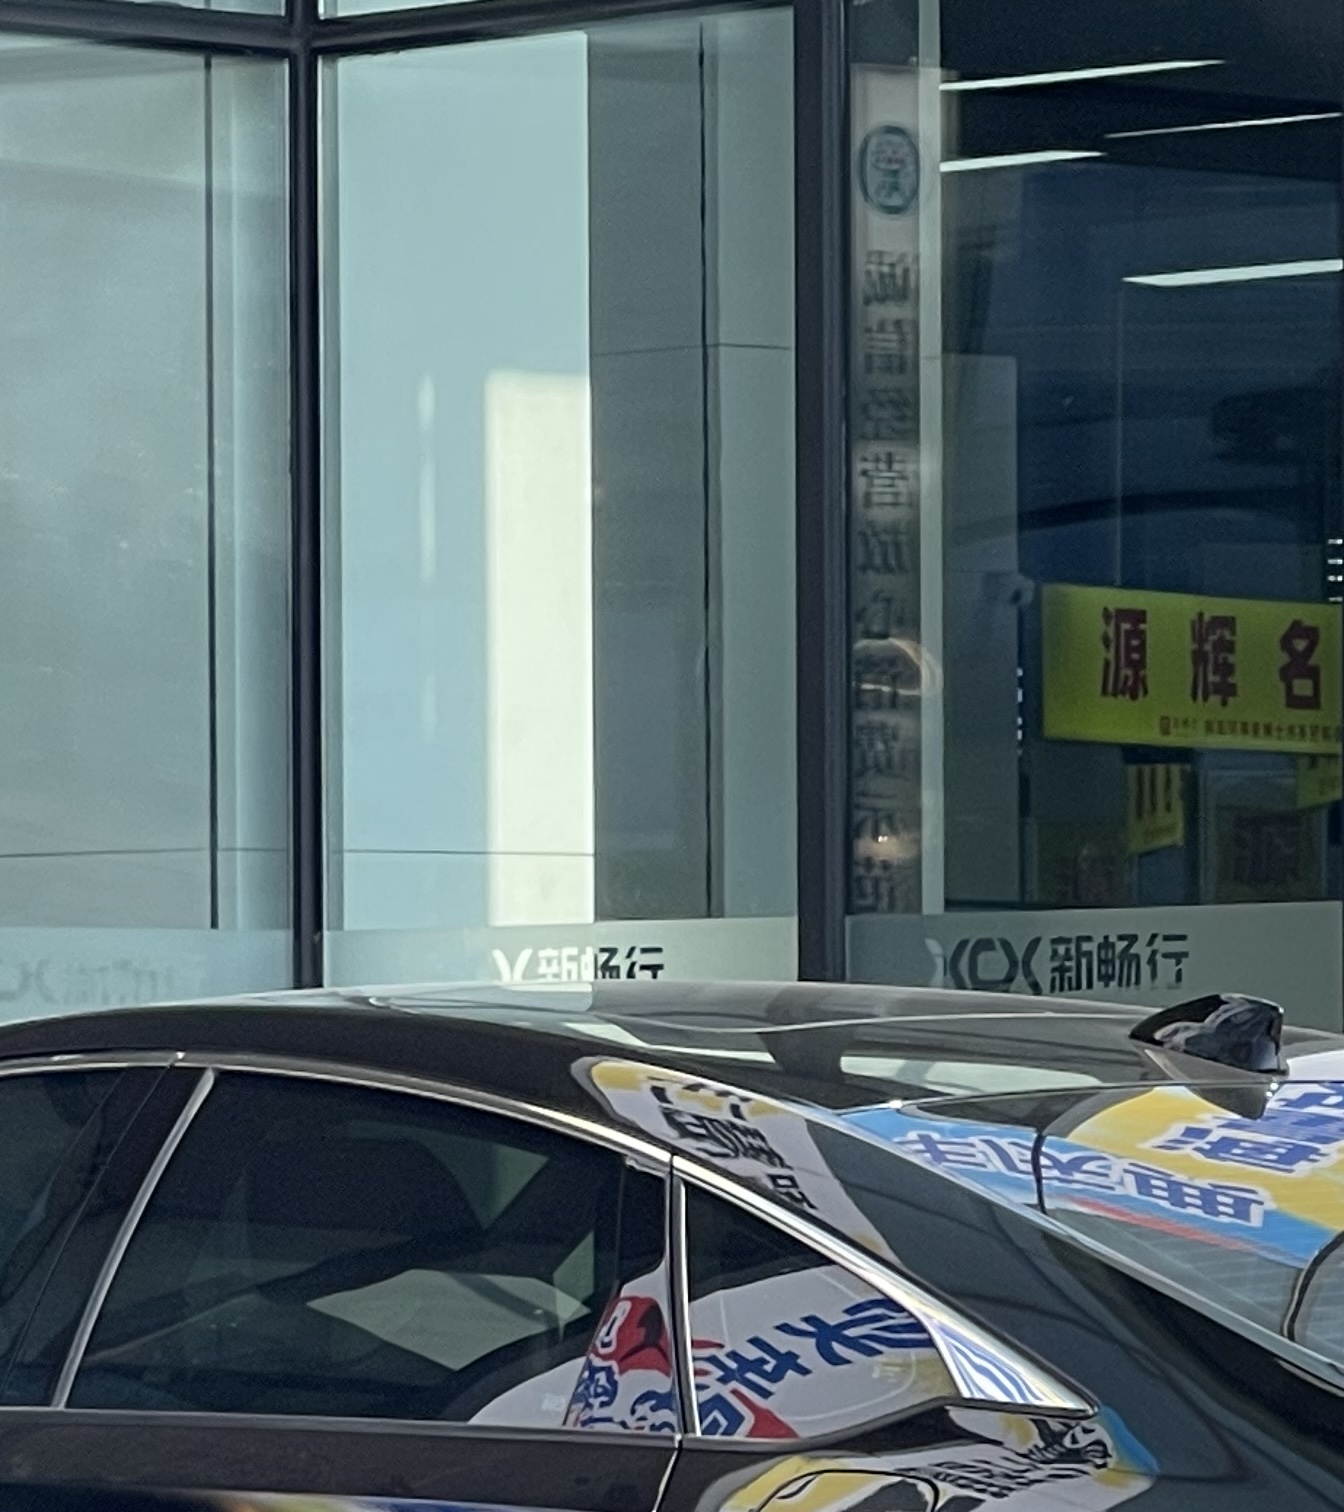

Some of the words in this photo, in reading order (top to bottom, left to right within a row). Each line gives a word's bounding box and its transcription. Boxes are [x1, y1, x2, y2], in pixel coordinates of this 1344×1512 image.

[1101, 607, 1323, 710] 源辉名
[1050, 933, 1189, 993] 新畅行
